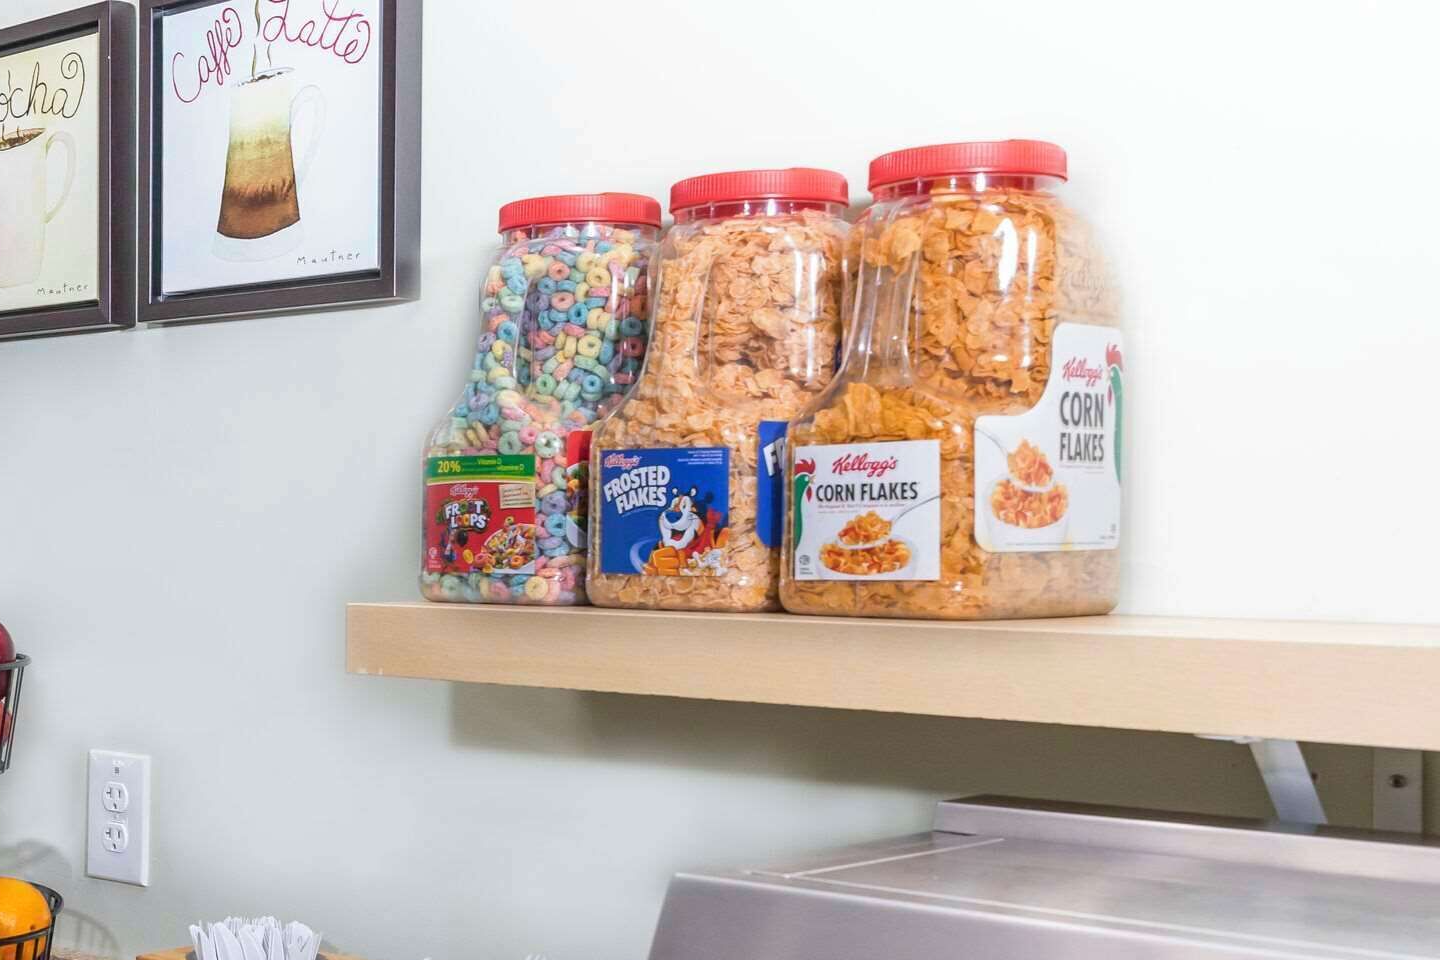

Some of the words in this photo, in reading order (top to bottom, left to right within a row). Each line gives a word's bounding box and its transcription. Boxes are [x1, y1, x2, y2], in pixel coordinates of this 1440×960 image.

[1060, 391, 1104, 427] CORN
[1060, 432, 1104, 463] FLAKES
[437, 460, 461, 473] 20%
[832, 453, 898, 477] Kellogg's
[603, 465, 671, 503] FROSTED
[816, 484, 855, 502] CORN
[861, 482, 918, 501] FLAKES
[615, 486, 668, 515] FLAKES
[450, 513, 488, 530] LOOPS
